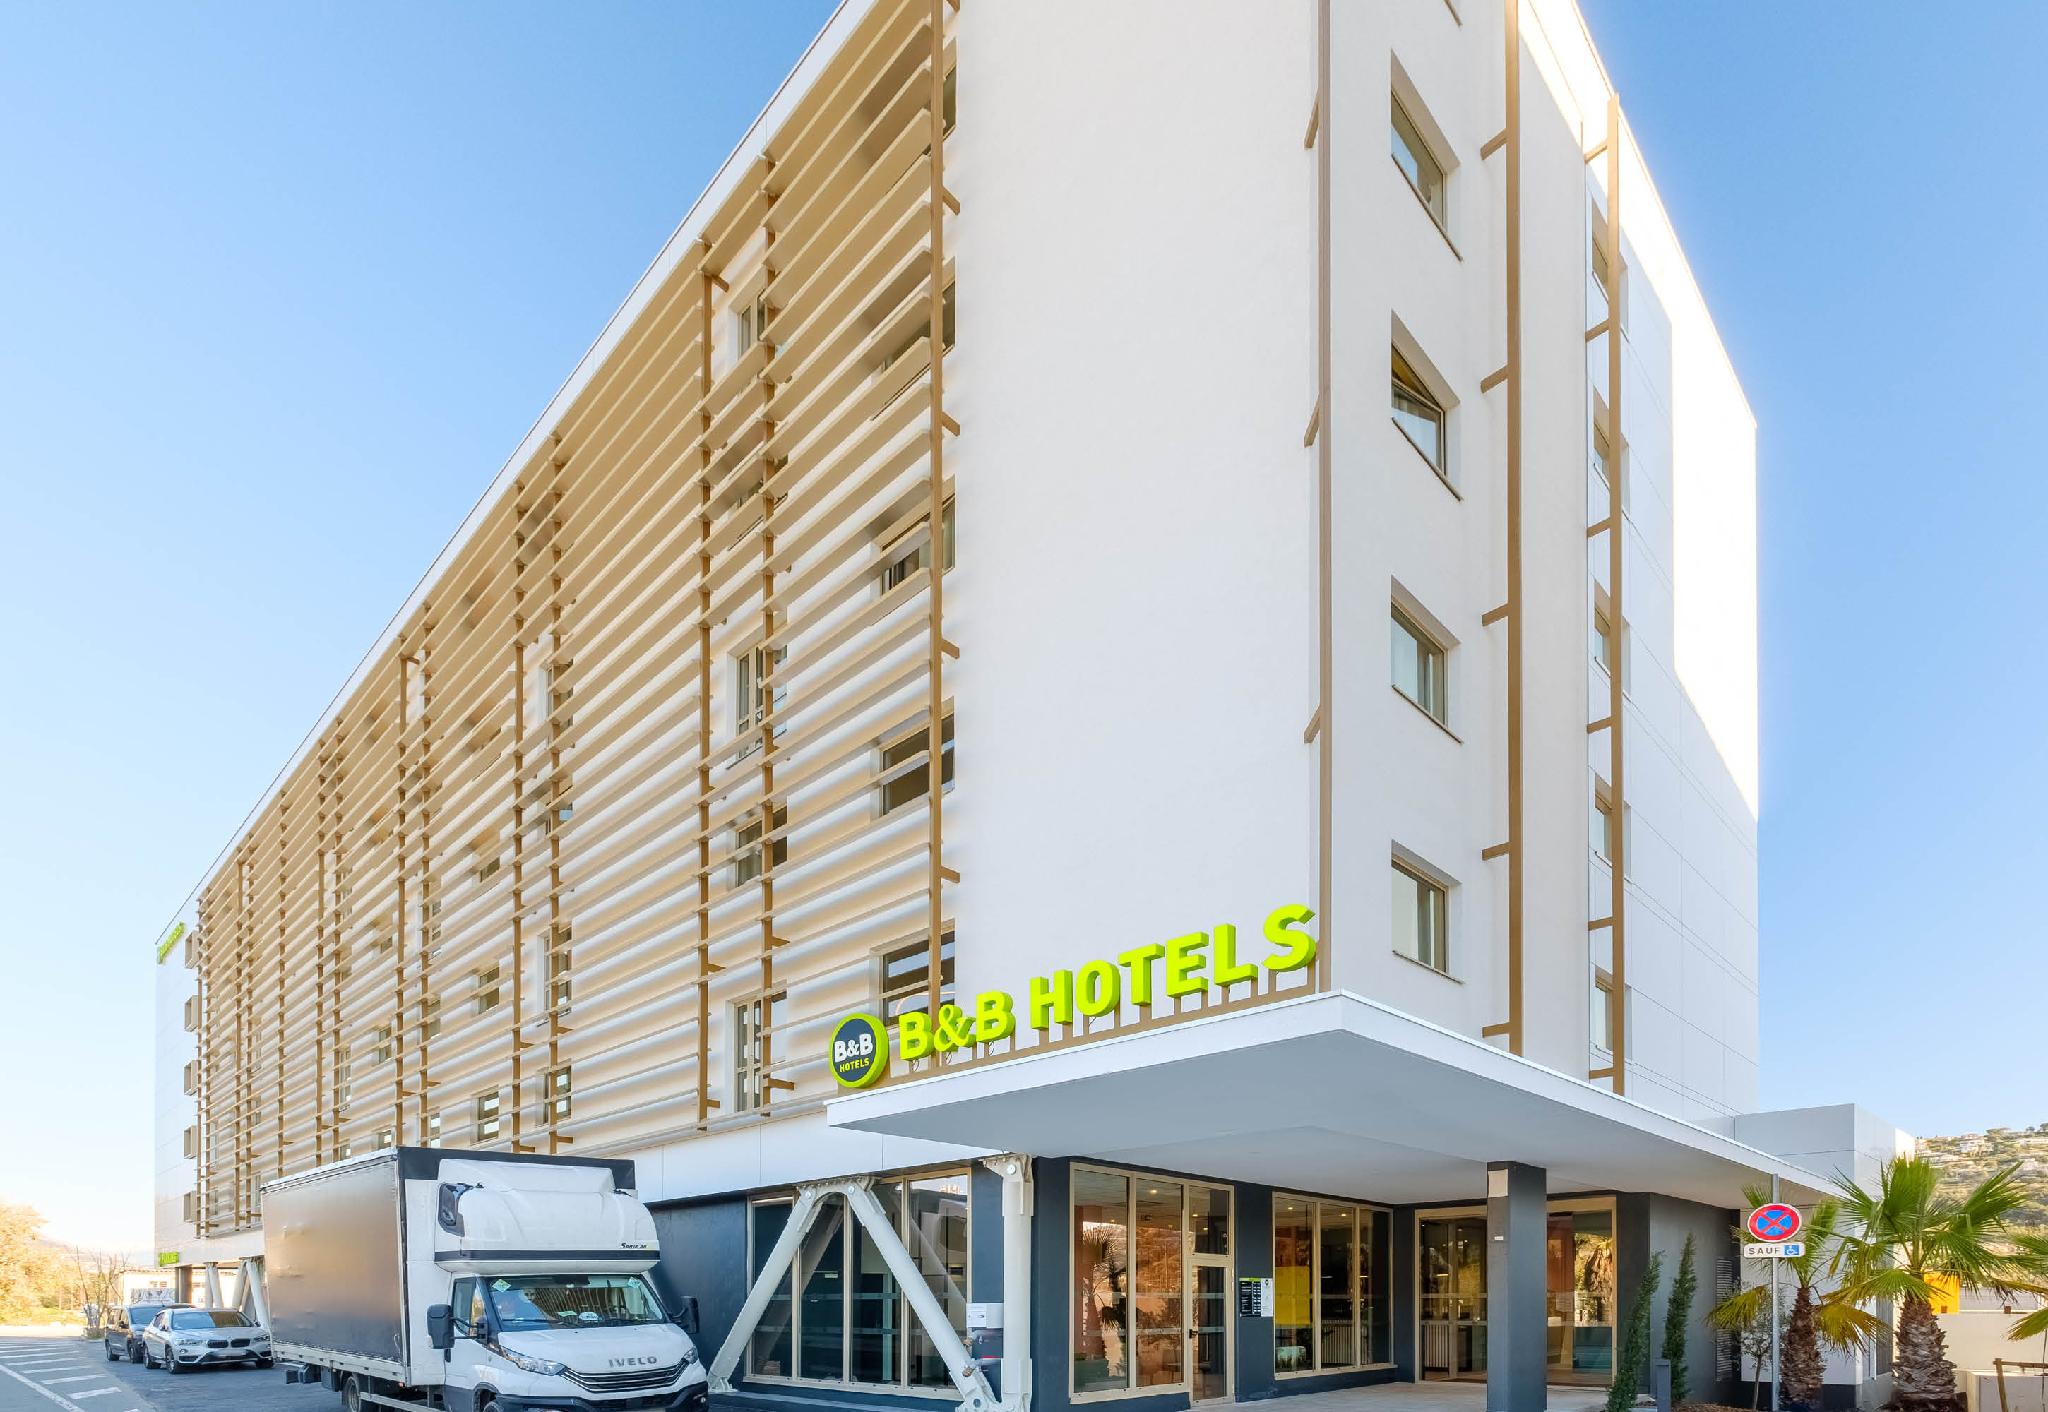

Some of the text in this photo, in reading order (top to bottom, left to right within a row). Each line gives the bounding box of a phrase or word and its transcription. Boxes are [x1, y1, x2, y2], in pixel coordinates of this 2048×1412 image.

[899, 904, 1315, 1061] B&B HOTELS
[834, 1033, 874, 1062] B&B
[839, 1057, 870, 1073] HOTELS
[1748, 1247, 1780, 1255] SAUF
